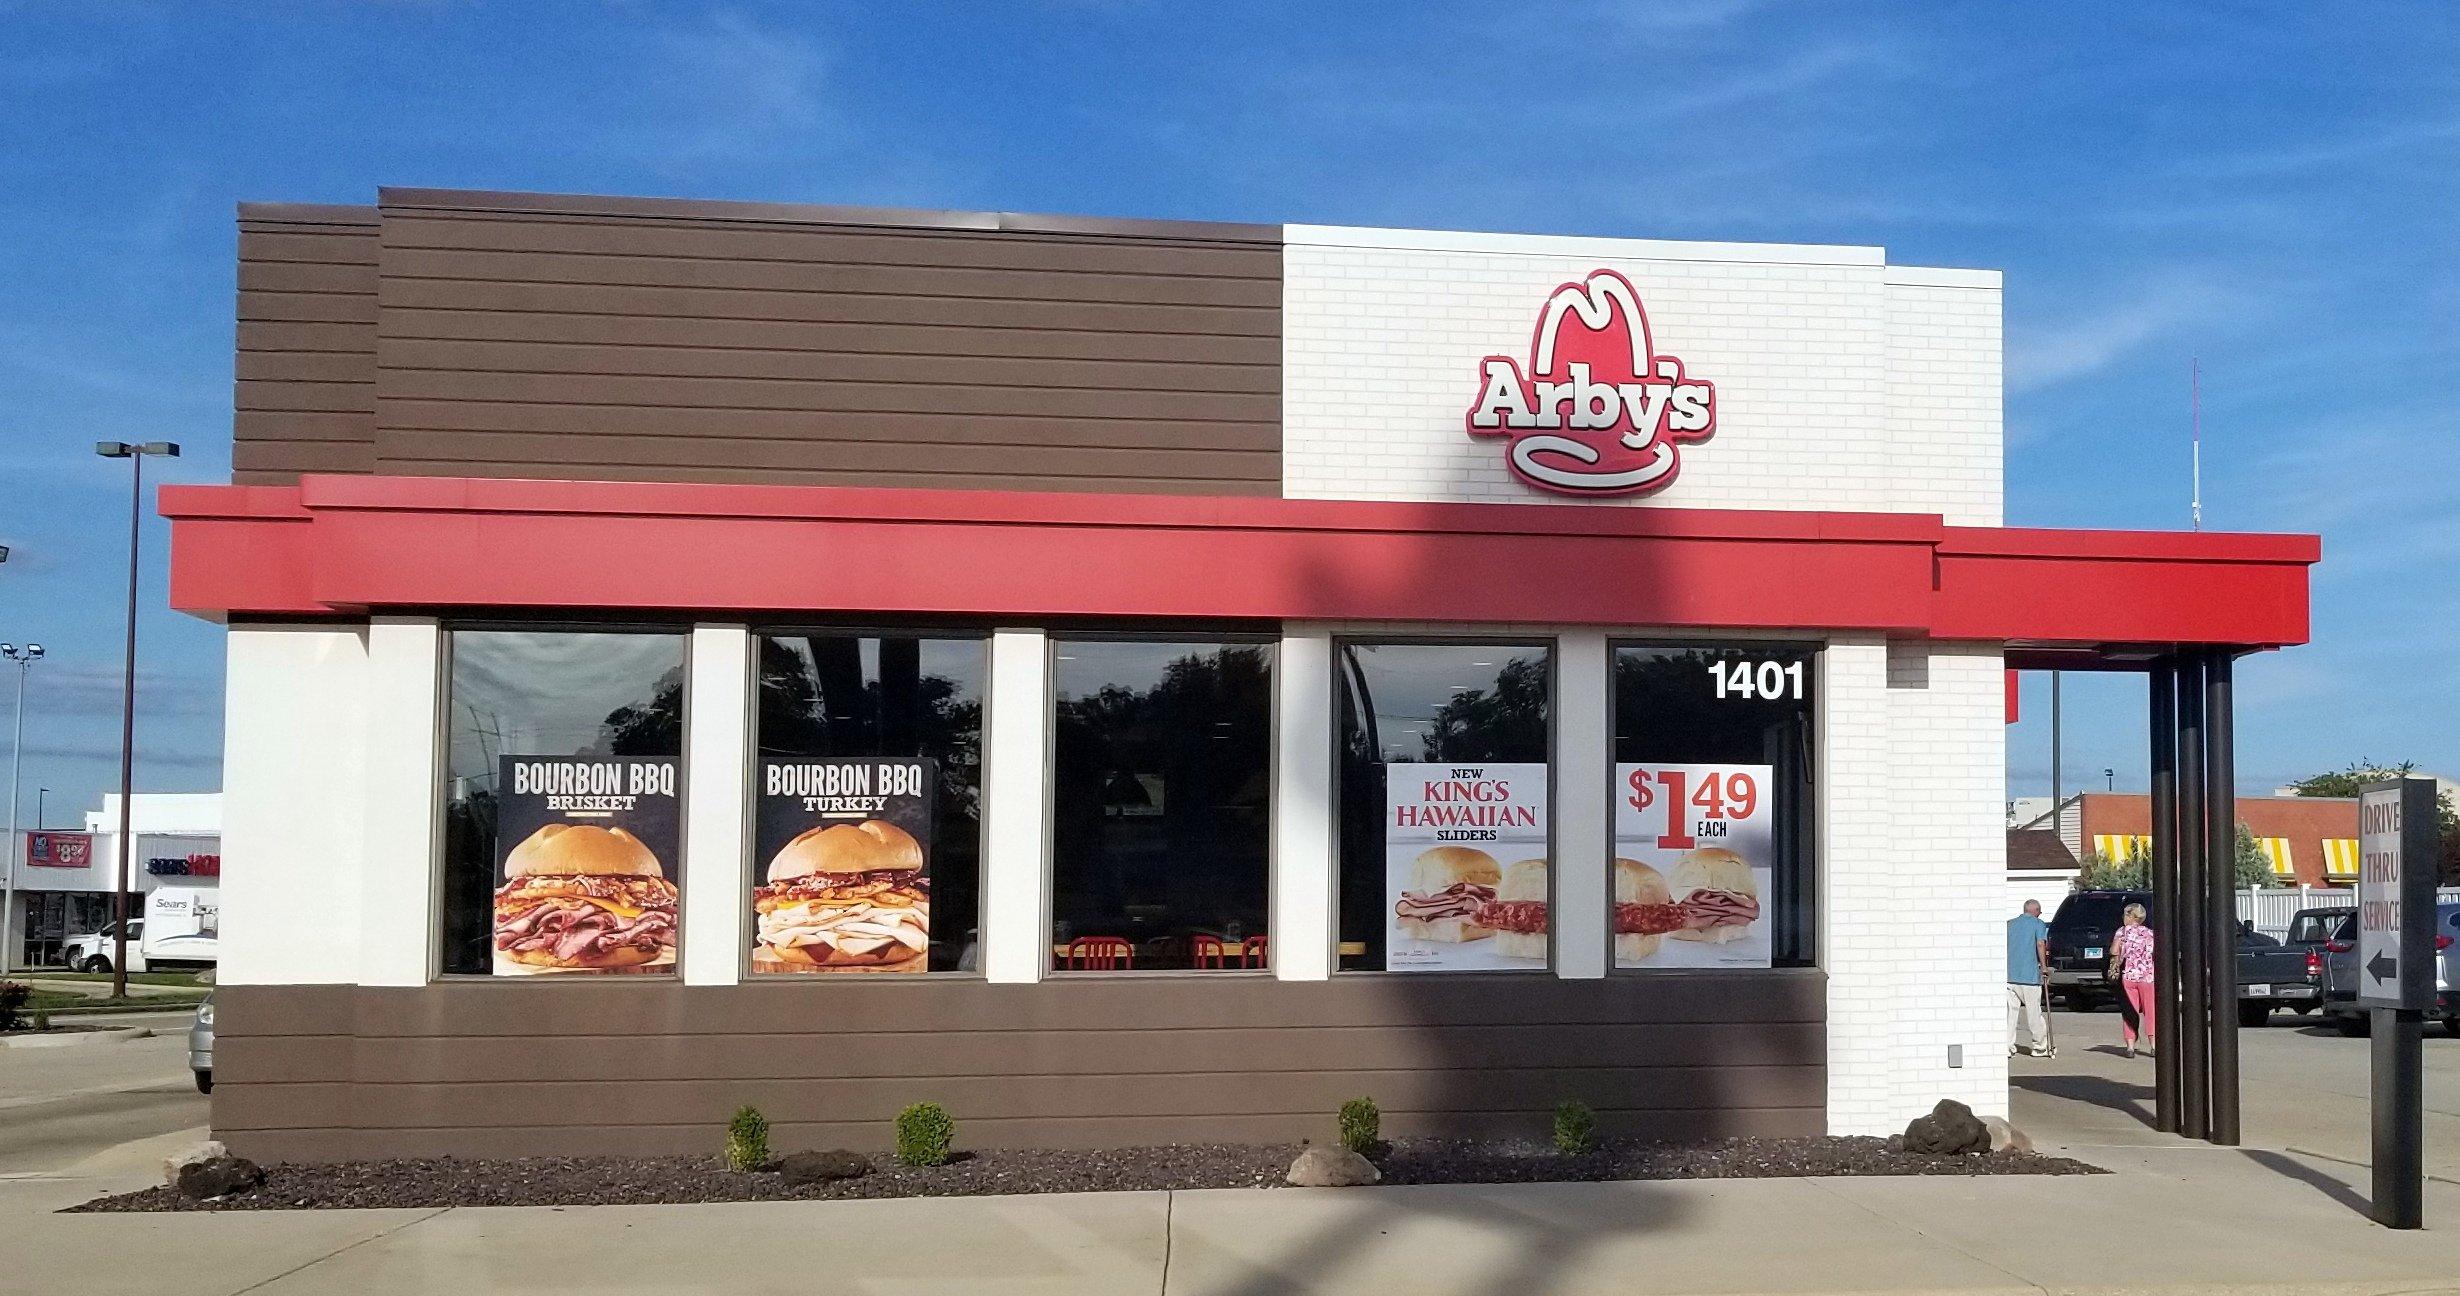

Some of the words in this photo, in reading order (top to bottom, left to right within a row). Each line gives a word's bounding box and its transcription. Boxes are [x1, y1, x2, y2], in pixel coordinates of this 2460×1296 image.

[1473, 361, 1712, 449] Arby's
[1708, 661, 1803, 700] 1401
[514, 762, 622, 795] BOURBON
[629, 763, 675, 797] BBQ
[767, 764, 871, 796] BOURBON
[878, 764, 922, 797] BBQ
[1451, 768, 1484, 779] NEW
[1424, 780, 1510, 802] KING'S
[546, 795, 637, 811] BRISKET
[803, 796, 888, 812] TURKEY
[1397, 805, 1536, 827] HAWAIIAN
[2364, 801, 2400, 835] DRIVE
[1437, 830, 1497, 841] SLIDERS
[1697, 821, 1727, 837] EACH
[2366, 851, 2399, 883] THRU
[156, 898, 187, 909] Sears
[2363, 900, 2400, 932] SERVICE
